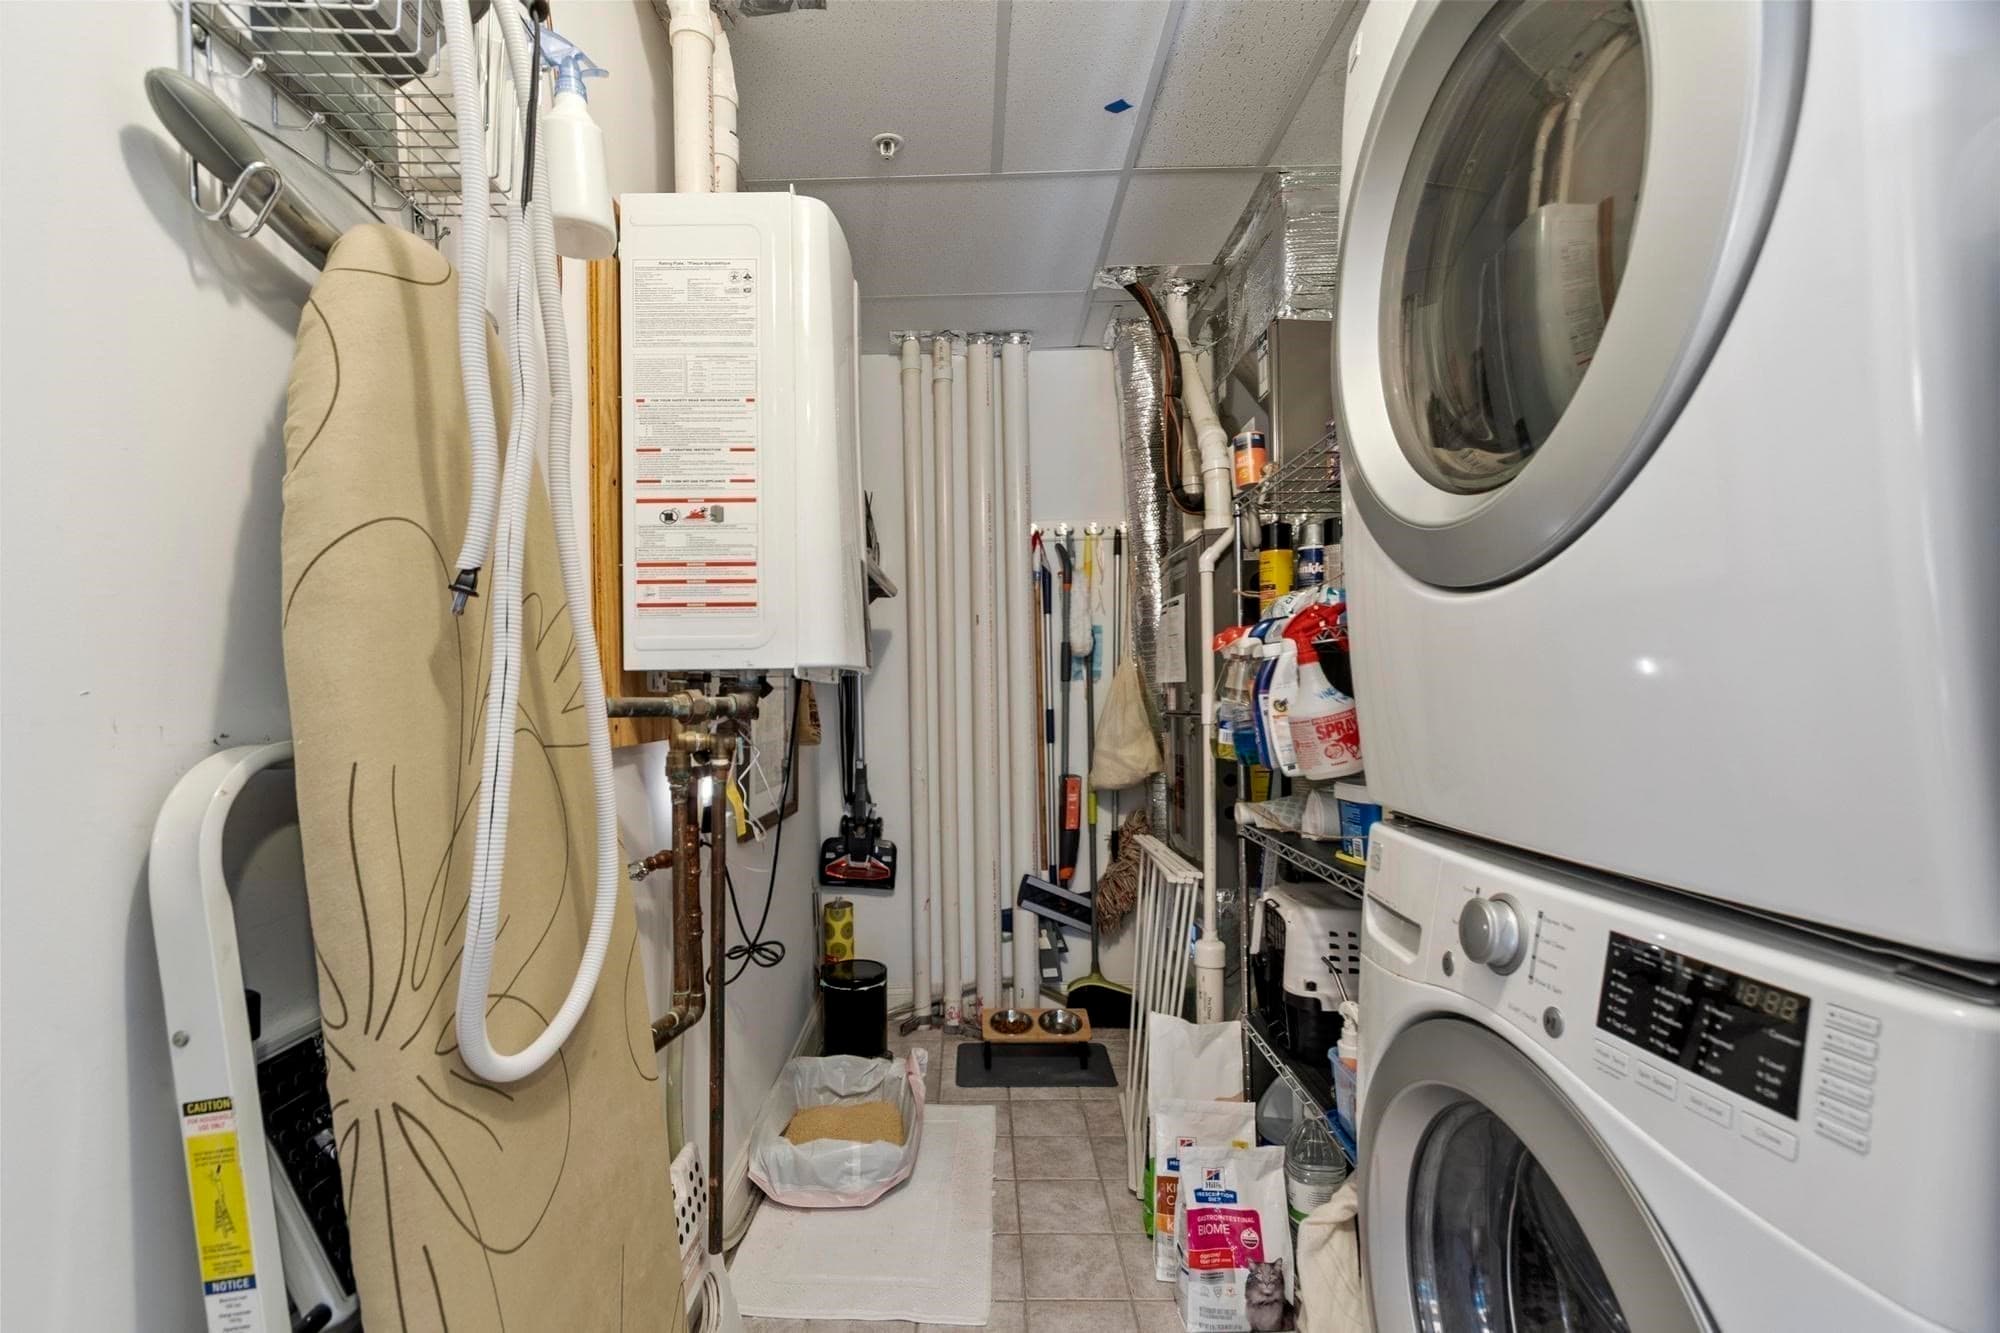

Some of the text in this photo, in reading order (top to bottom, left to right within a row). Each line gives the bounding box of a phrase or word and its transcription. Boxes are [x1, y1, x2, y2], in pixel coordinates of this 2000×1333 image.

[186, 1098, 231, 1114] CAUTION
[1197, 1214, 1255, 1224] GASTROINTESTINAL
[1197, 1223, 1231, 1236] BIOME
[212, 1277, 250, 1292] NOTICE
